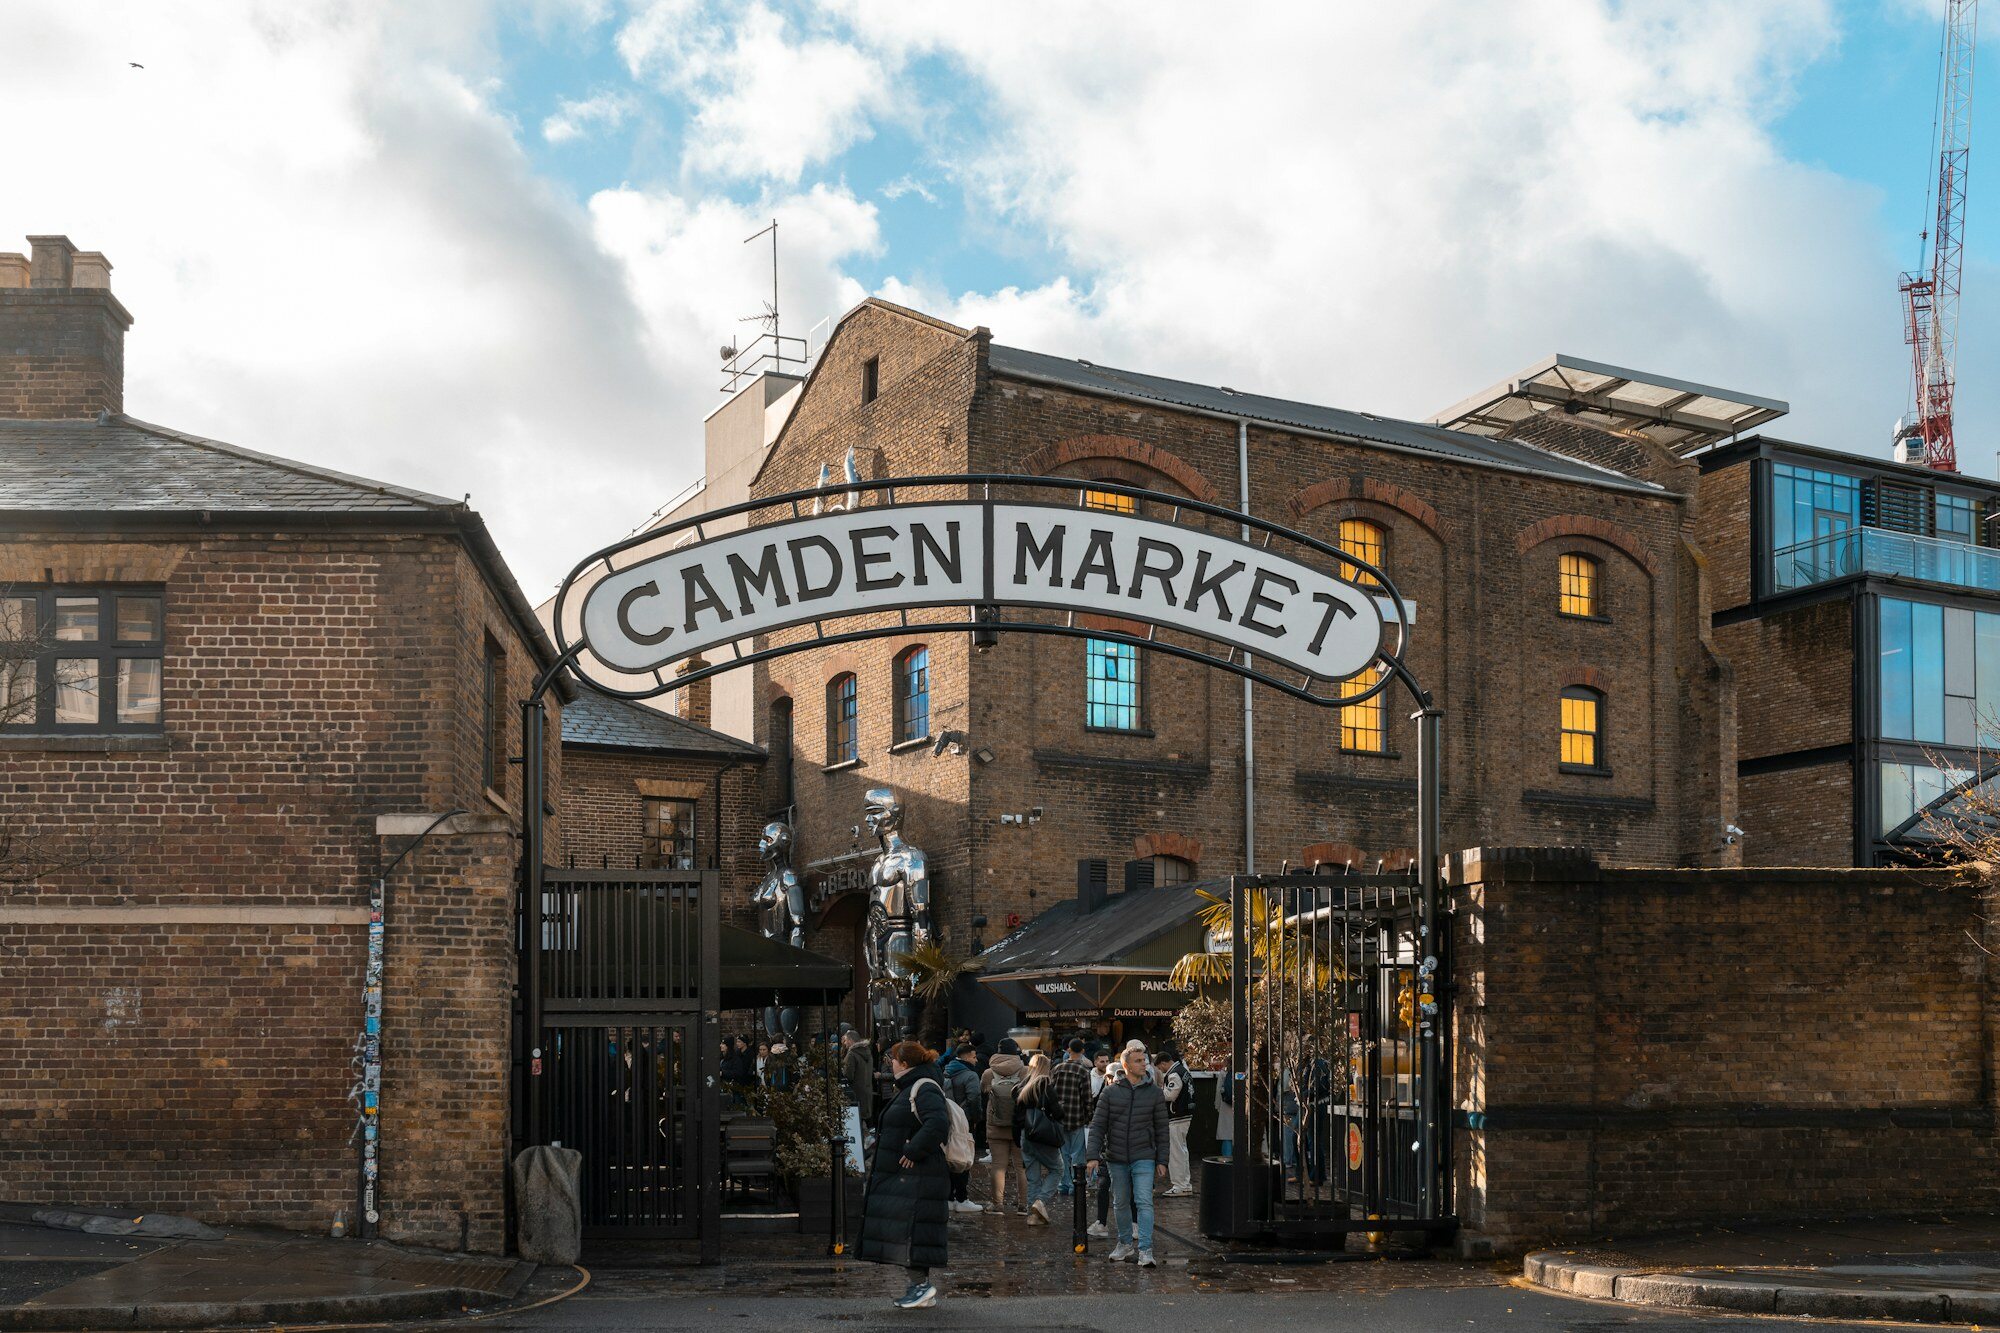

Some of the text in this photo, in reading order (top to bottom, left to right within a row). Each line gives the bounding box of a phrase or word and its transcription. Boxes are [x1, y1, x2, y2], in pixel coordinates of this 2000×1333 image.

[616, 520, 1358, 657] CAMDEN MARKET
[809, 868, 869, 912] CYBERD
[1114, 1008, 1173, 1017] Dutch Pancakes
